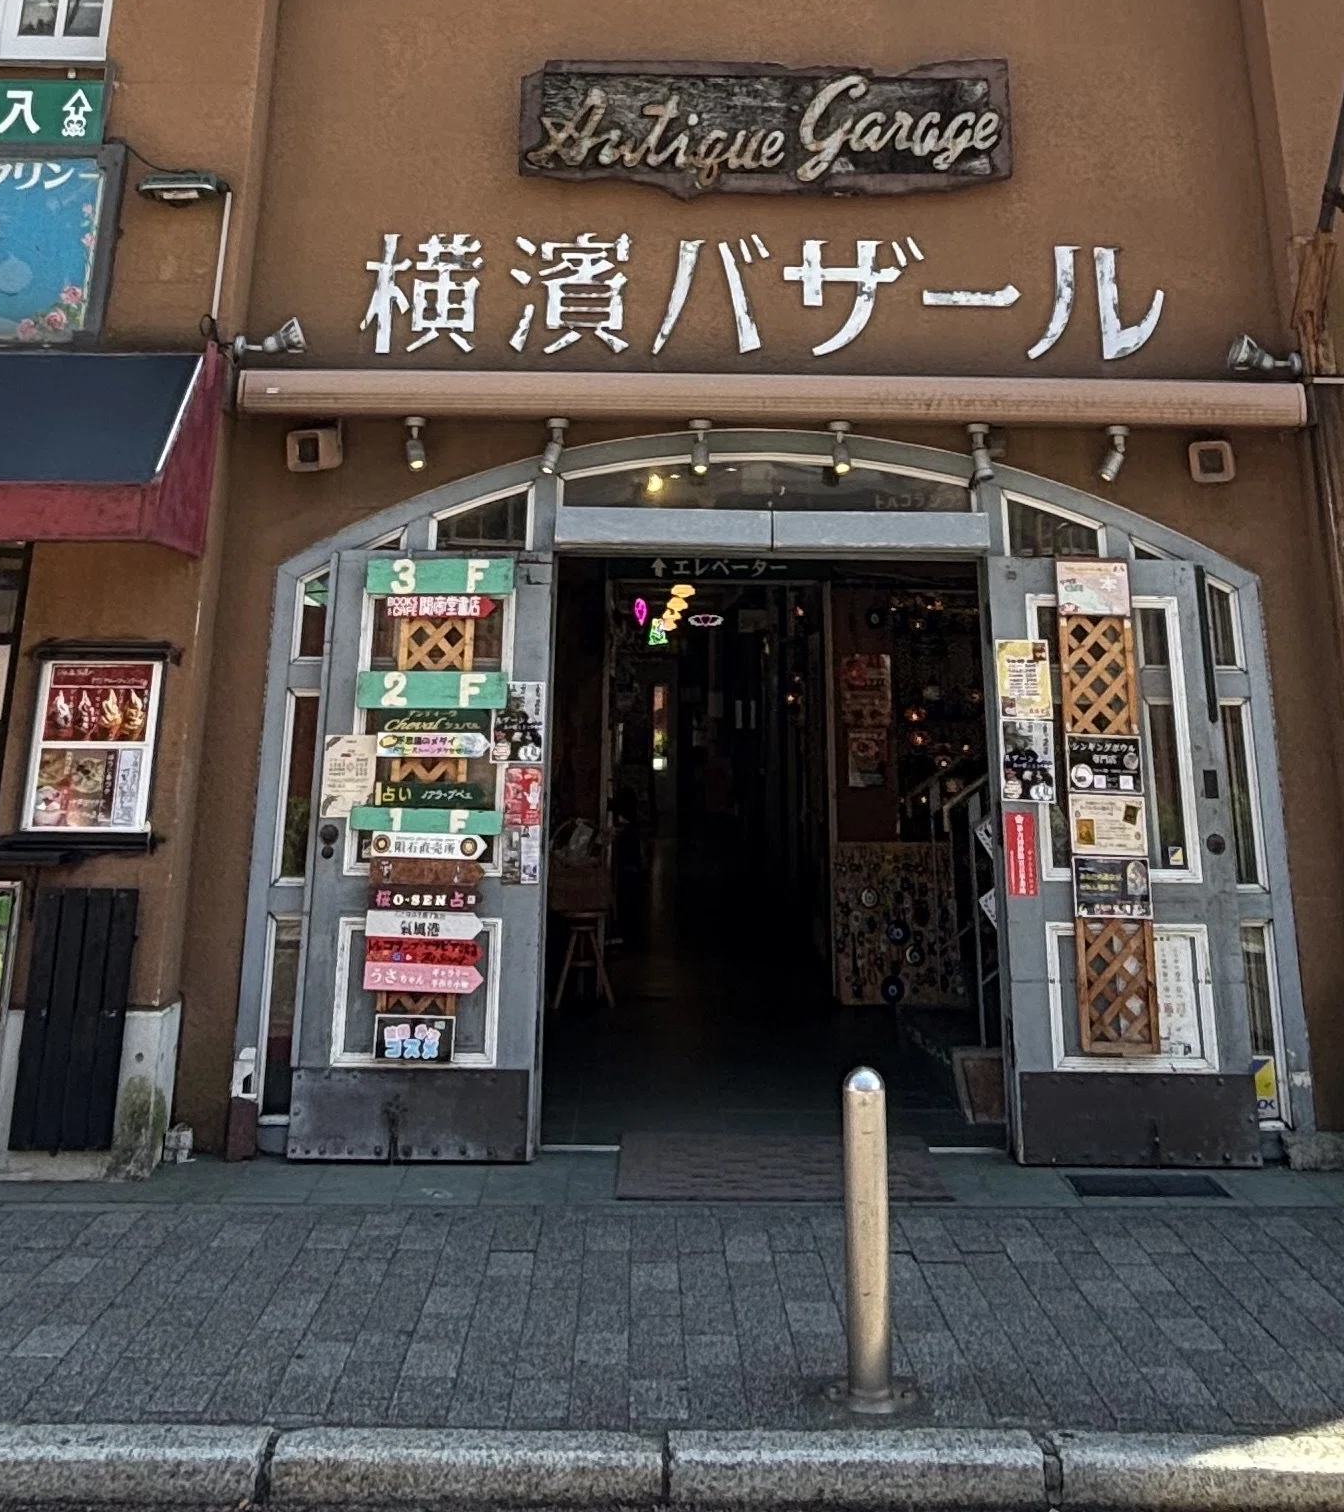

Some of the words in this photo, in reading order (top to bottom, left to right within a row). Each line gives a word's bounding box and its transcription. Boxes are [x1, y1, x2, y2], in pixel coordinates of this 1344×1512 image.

[530, 88, 786, 185] Antique
[791, 76, 1001, 181] Garage
[361, 233, 1164, 360] 横濱バザール
[673, 559, 788, 577] エレベーター
[387, 596, 418, 606] BOOKS
[384, 717, 446, 731] Cheval
[382, 787, 412, 802] 占い
